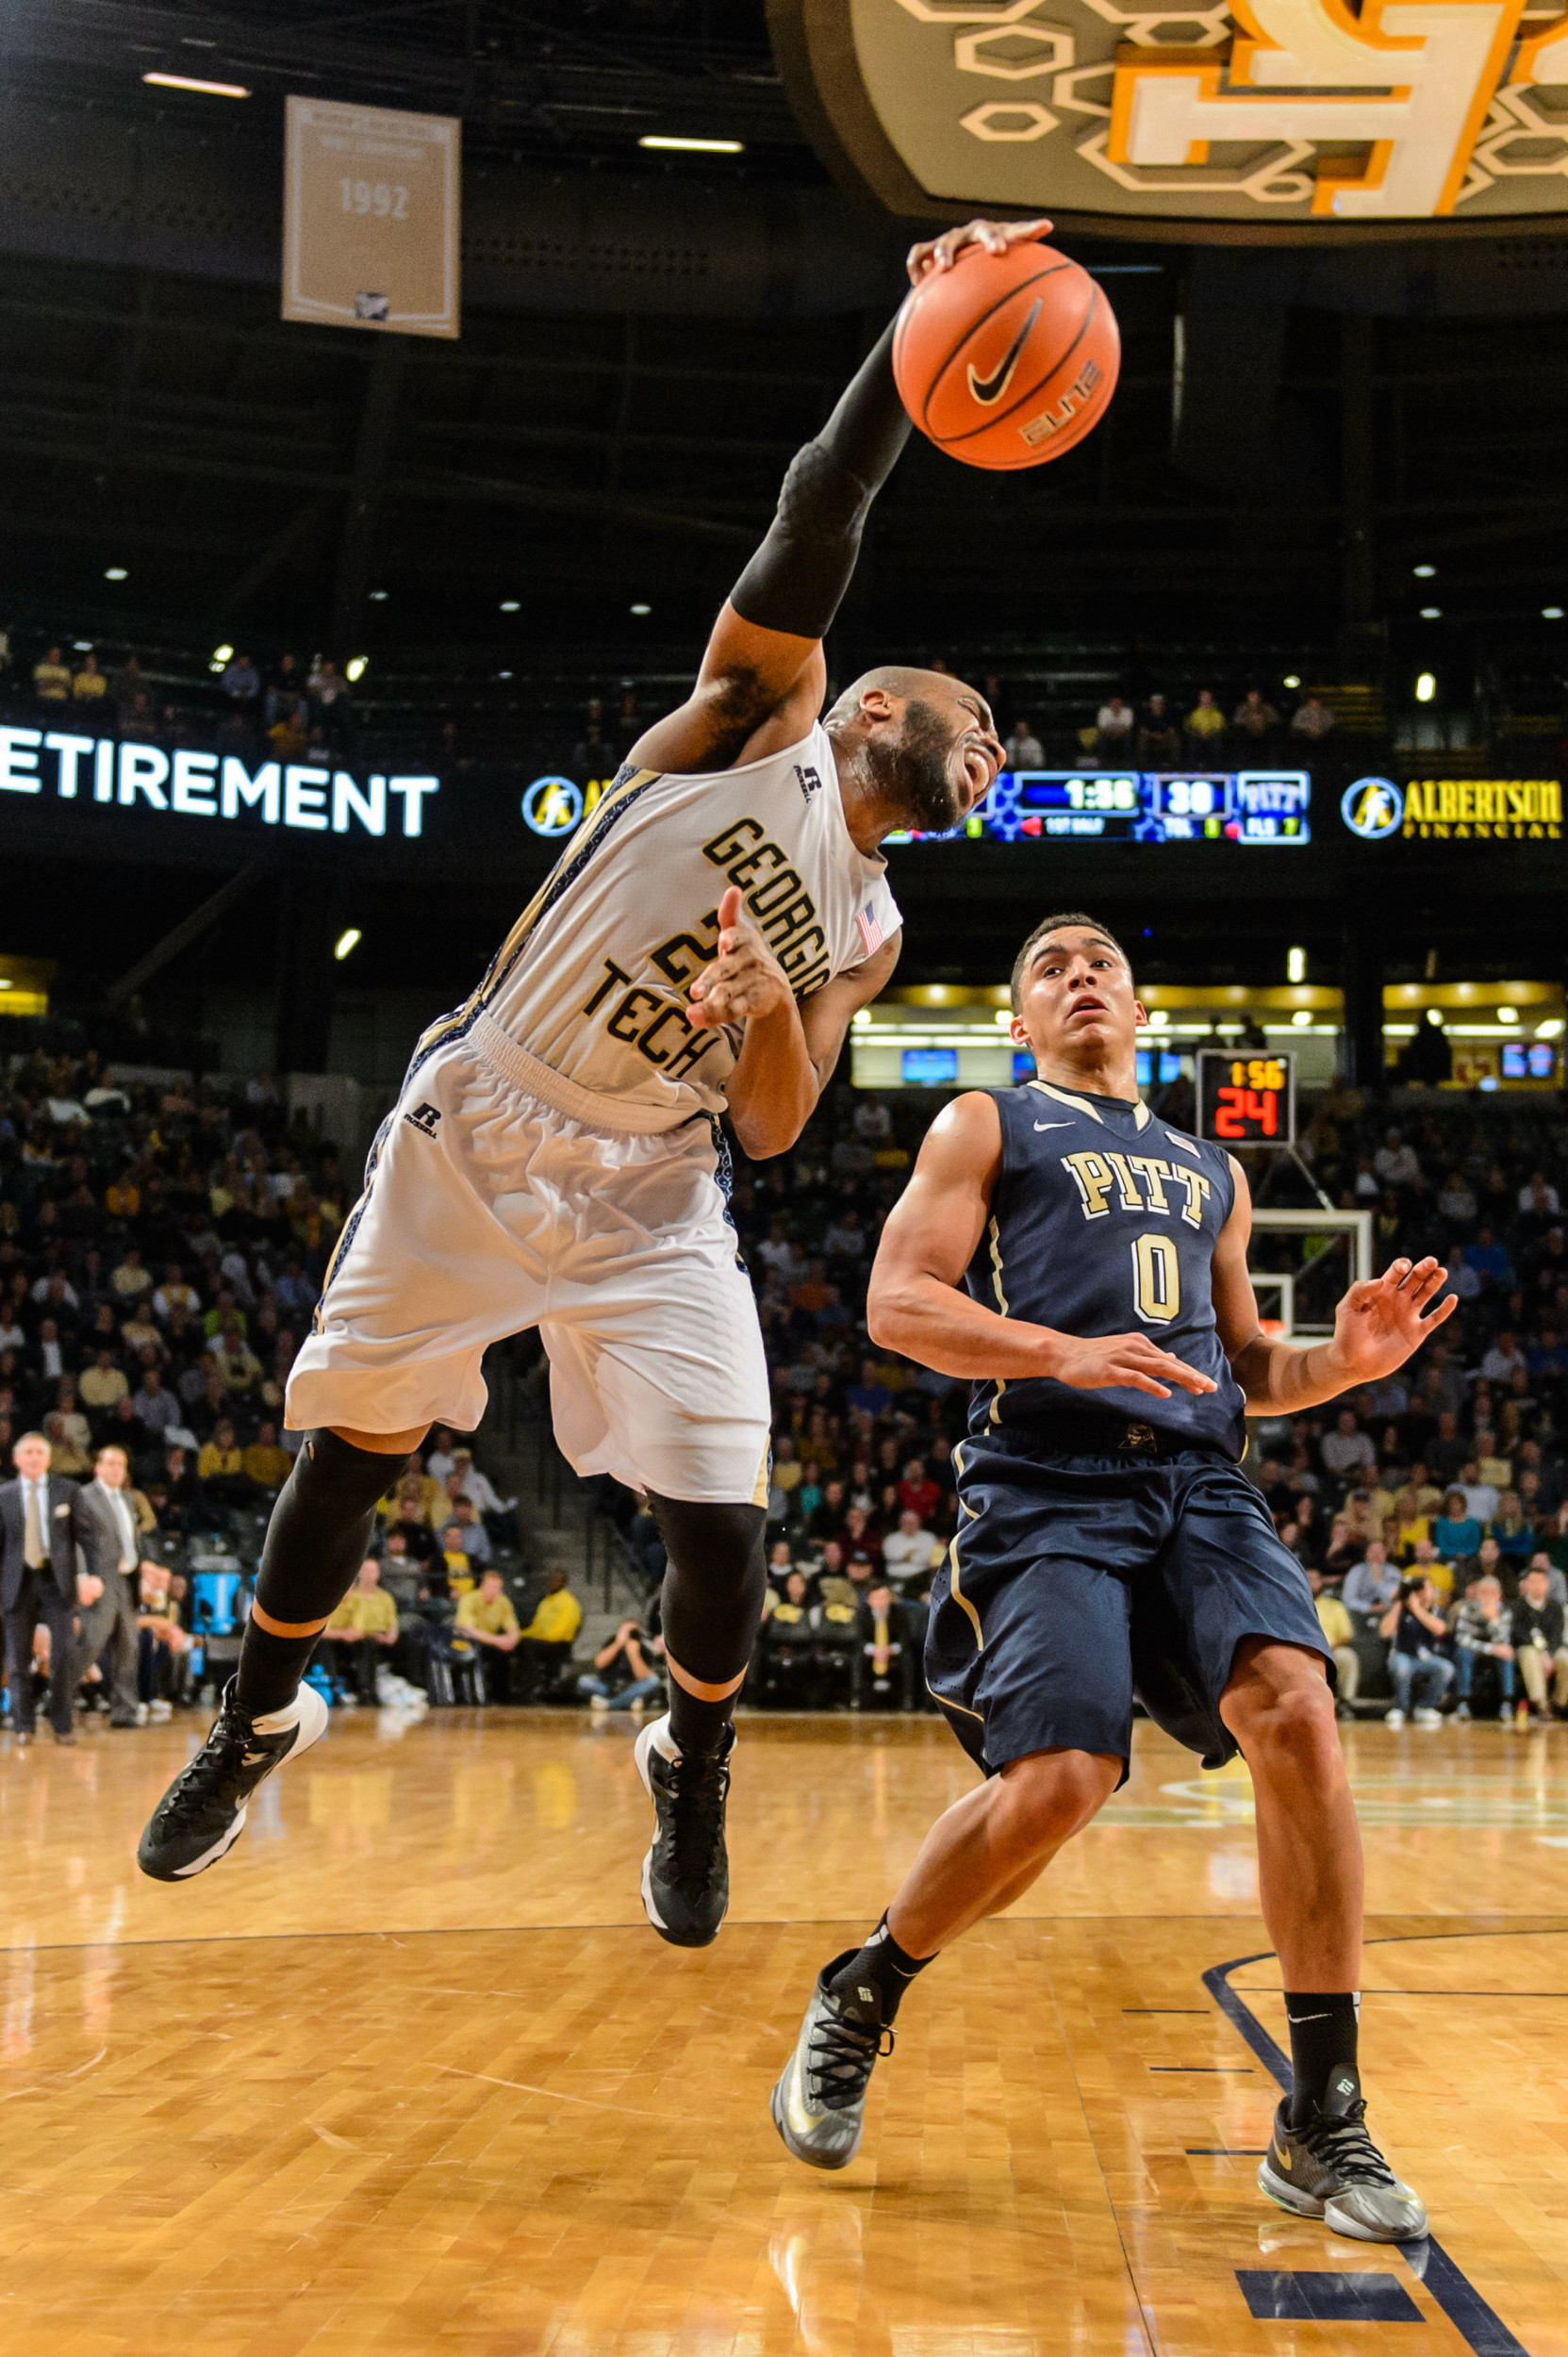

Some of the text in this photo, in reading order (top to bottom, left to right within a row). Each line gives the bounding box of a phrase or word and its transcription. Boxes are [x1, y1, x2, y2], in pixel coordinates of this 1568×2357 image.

[339, 177, 408, 221] 1992
[1016, 358, 1103, 446] ELITE
[1064, 778, 1136, 810] 1:56
[1245, 783, 1300, 815] PITT
[1403, 781, 1562, 823] ALBERTSON
[582, 957, 722, 1079] TECH
[1214, 1086, 1278, 1138] 24
[1060, 1150, 1211, 1230] PITT
[1131, 1232, 1180, 1326] 0
